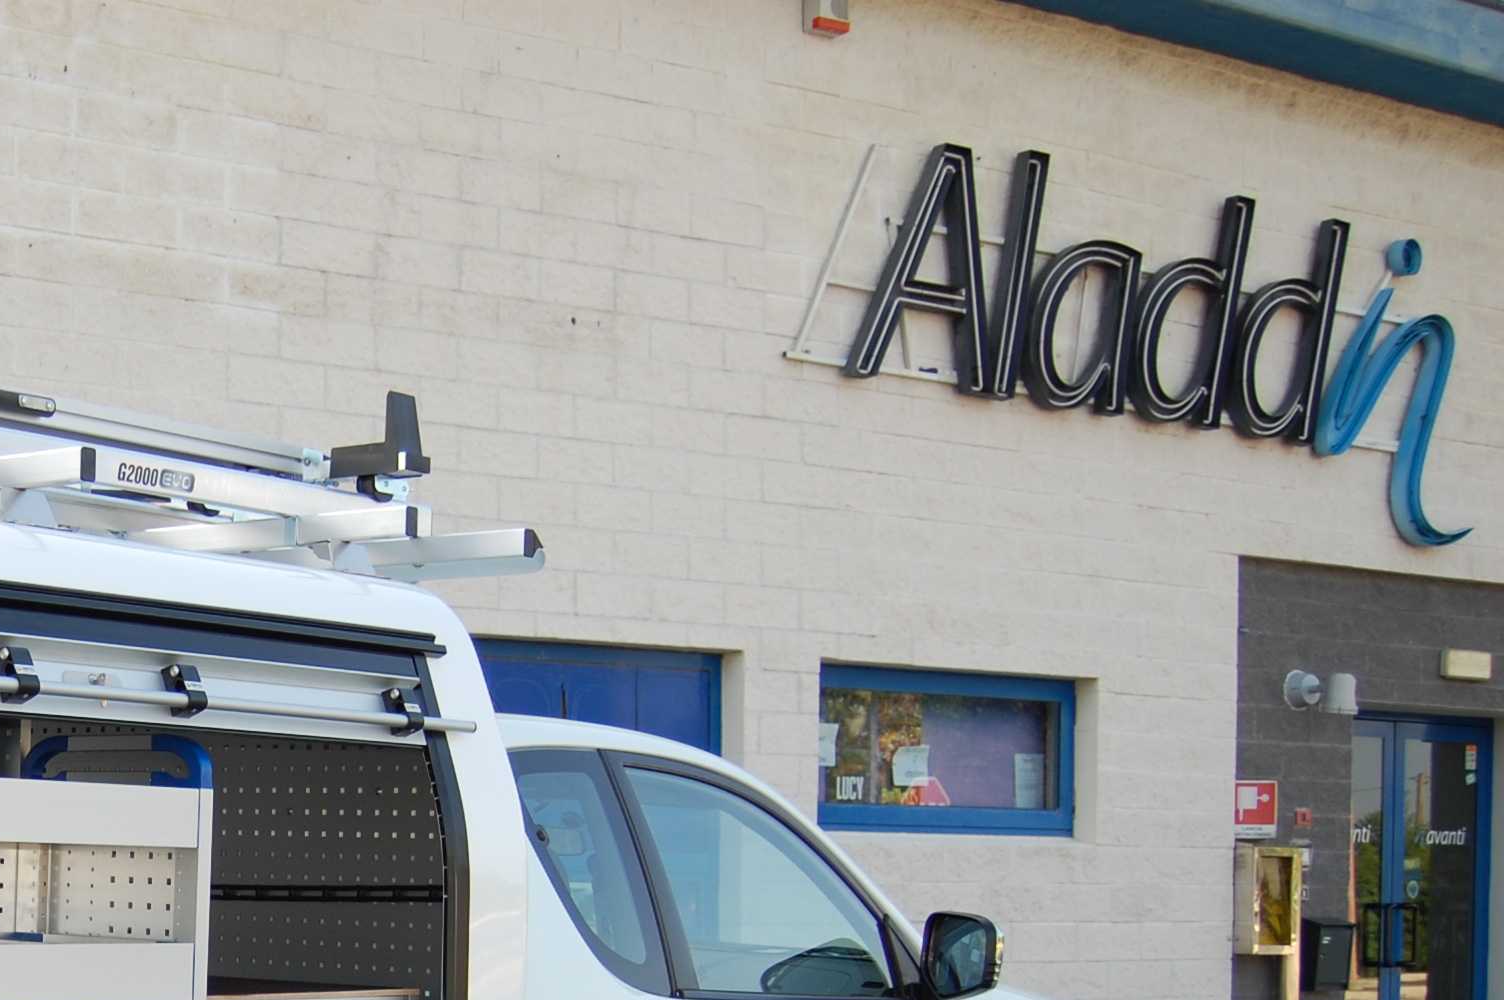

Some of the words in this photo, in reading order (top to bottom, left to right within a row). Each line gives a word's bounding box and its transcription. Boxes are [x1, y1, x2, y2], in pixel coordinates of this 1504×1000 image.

[844, 142, 1474, 548] Aladdin
[117, 462, 159, 487] G2000
[162, 472, 191, 490] EVO
[836, 776, 864, 801] LUCY
[1426, 826, 1466, 846] avanti
